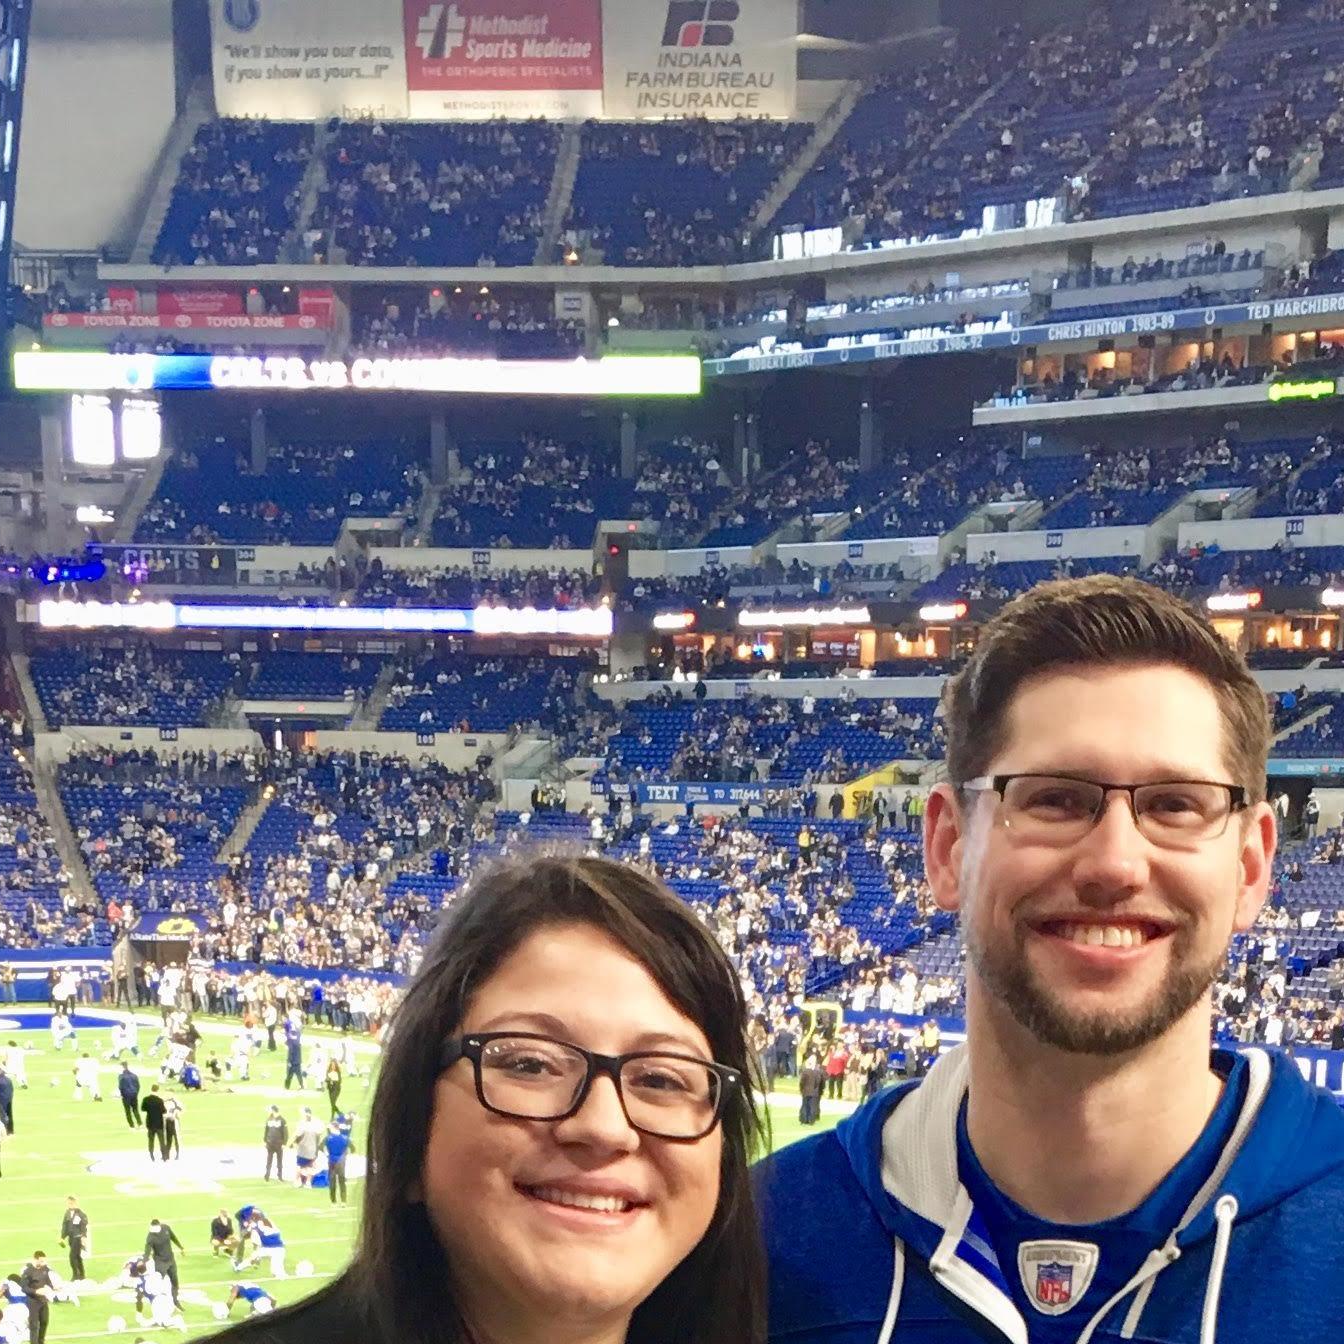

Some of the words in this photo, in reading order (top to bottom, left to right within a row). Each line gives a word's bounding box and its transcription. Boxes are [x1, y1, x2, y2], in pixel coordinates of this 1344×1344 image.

[470, 14, 549, 35] Methodist
[264, 45, 300, 59] show
[303, 47, 328, 62] you
[332, 47, 356, 59] our
[465, 38, 517, 61] Sports
[521, 38, 592, 58] Medicine
[658, 52, 742, 68] INDIANA
[237, 69, 262, 83] you
[266, 65, 302, 80] show
[637, 92, 760, 109] INSURANCE
[83, 314, 127, 327] TOYOTA
[129, 314, 161, 327] ZONE
[207, 316, 250, 329] TOYOTA
[253, 316, 285, 329] ZONE
[1048, 325, 1081, 341] CHRIS
[1084, 320, 1126, 337] HINTON
[1247, 303, 1272, 320] TED
[646, 785, 679, 800] TEXT
